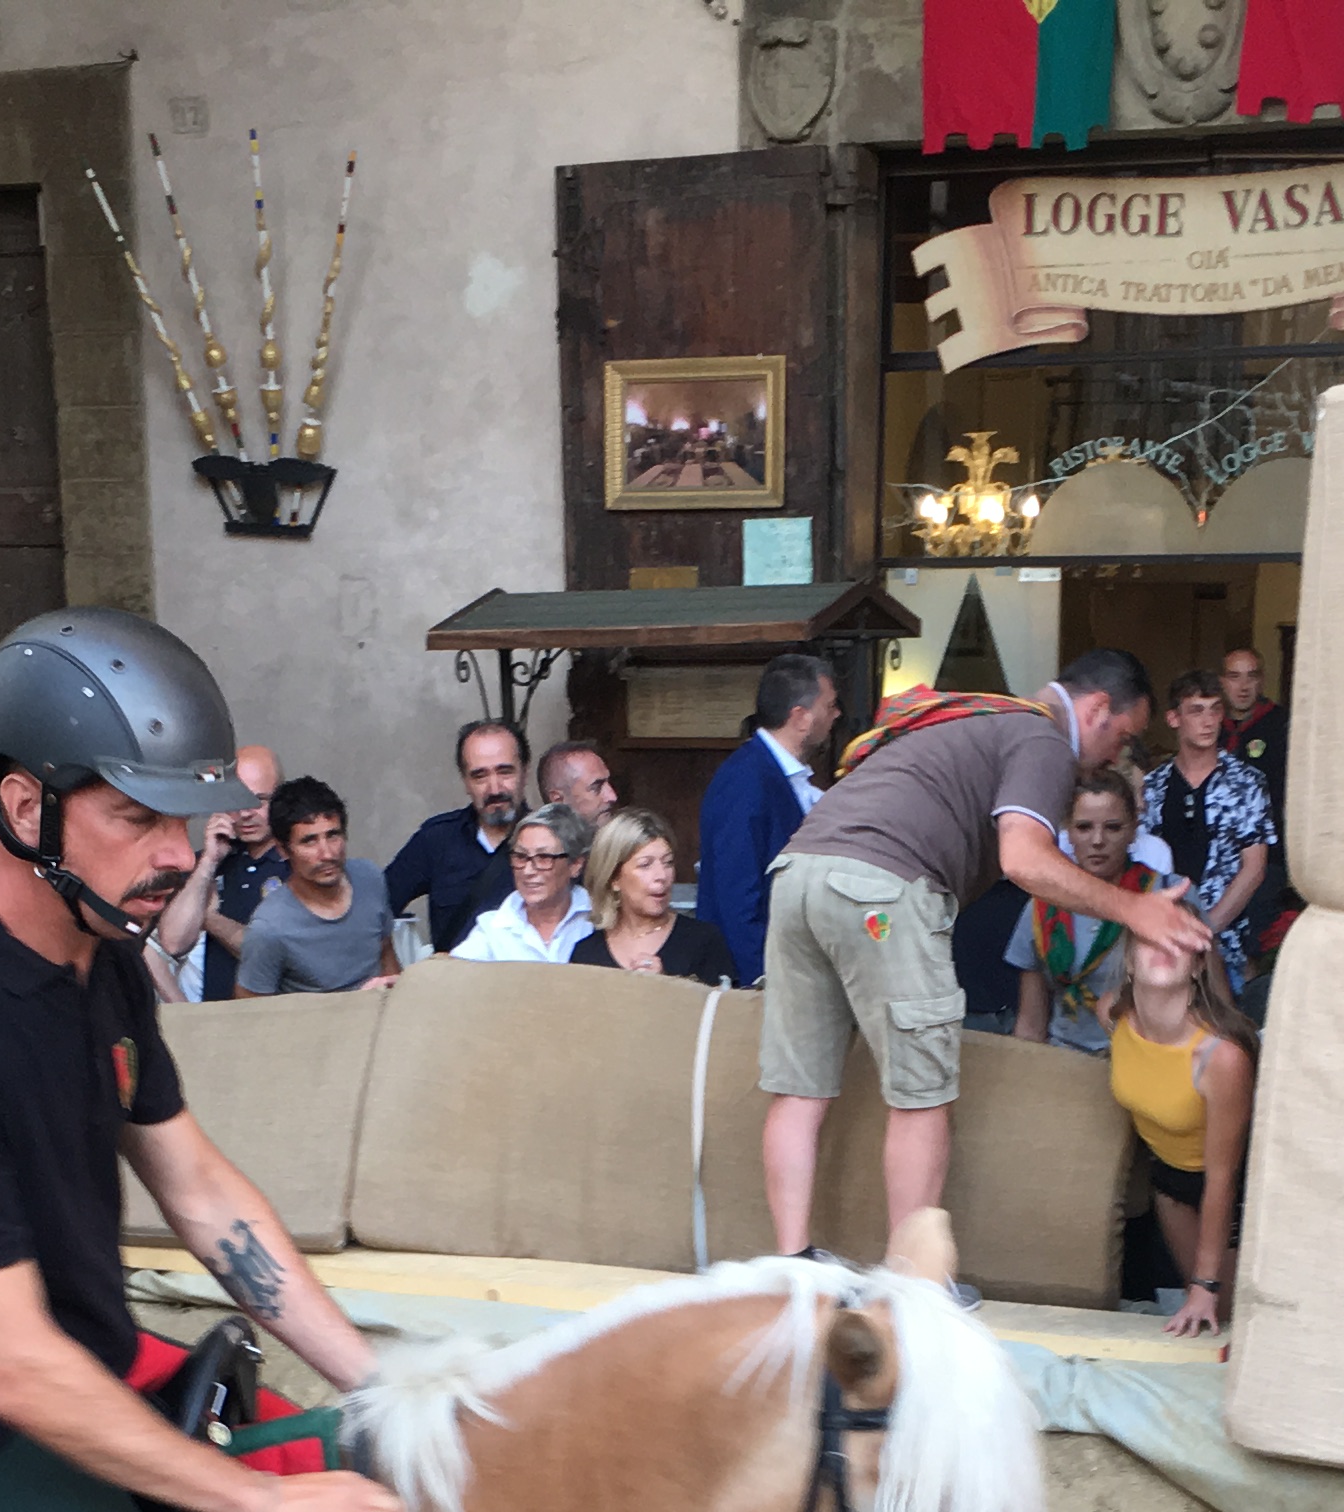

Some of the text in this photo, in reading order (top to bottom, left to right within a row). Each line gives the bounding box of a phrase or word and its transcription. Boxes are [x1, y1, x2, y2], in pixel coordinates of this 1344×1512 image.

[1021, 191, 1186, 237] LOGGE
[1026, 272, 1110, 298] ANTICA
[1119, 277, 1246, 303] TRATTORIA
[1048, 435, 1185, 477] RISTORANTE
[1207, 431, 1287, 485] LOGGE
